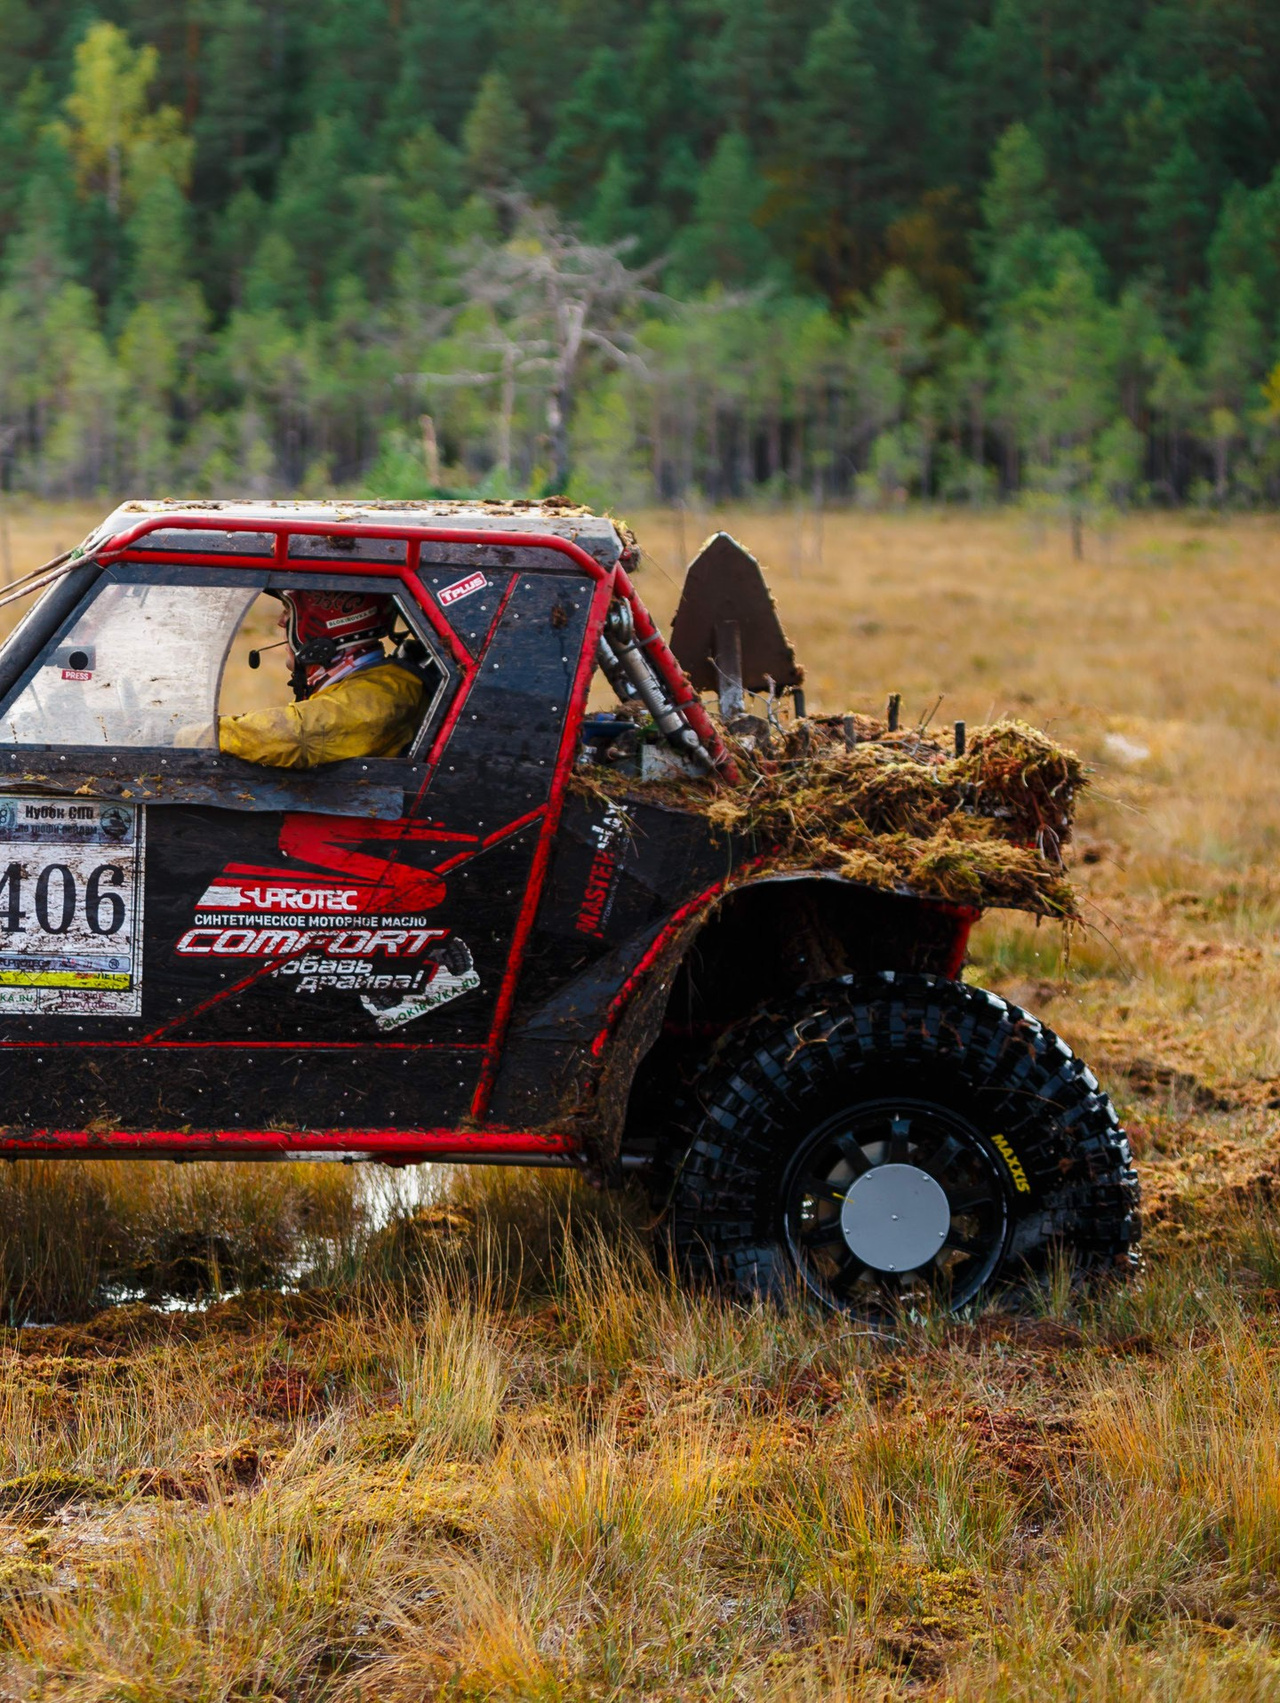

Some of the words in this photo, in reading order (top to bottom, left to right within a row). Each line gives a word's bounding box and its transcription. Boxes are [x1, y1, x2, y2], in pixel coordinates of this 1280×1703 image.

[65, 671, 89, 680] PRESS
[237, 887, 358, 911] SUPROTEC
[194, 914, 306, 927] СИНТЕТИЧЕСКОЕ
[308, 915, 379, 927] МОТОРНОЕ
[381, 916, 428, 927] МАСЛО
[176, 929, 446, 954] COMFORT
[991, 1133, 1031, 1194] MAXXIS
